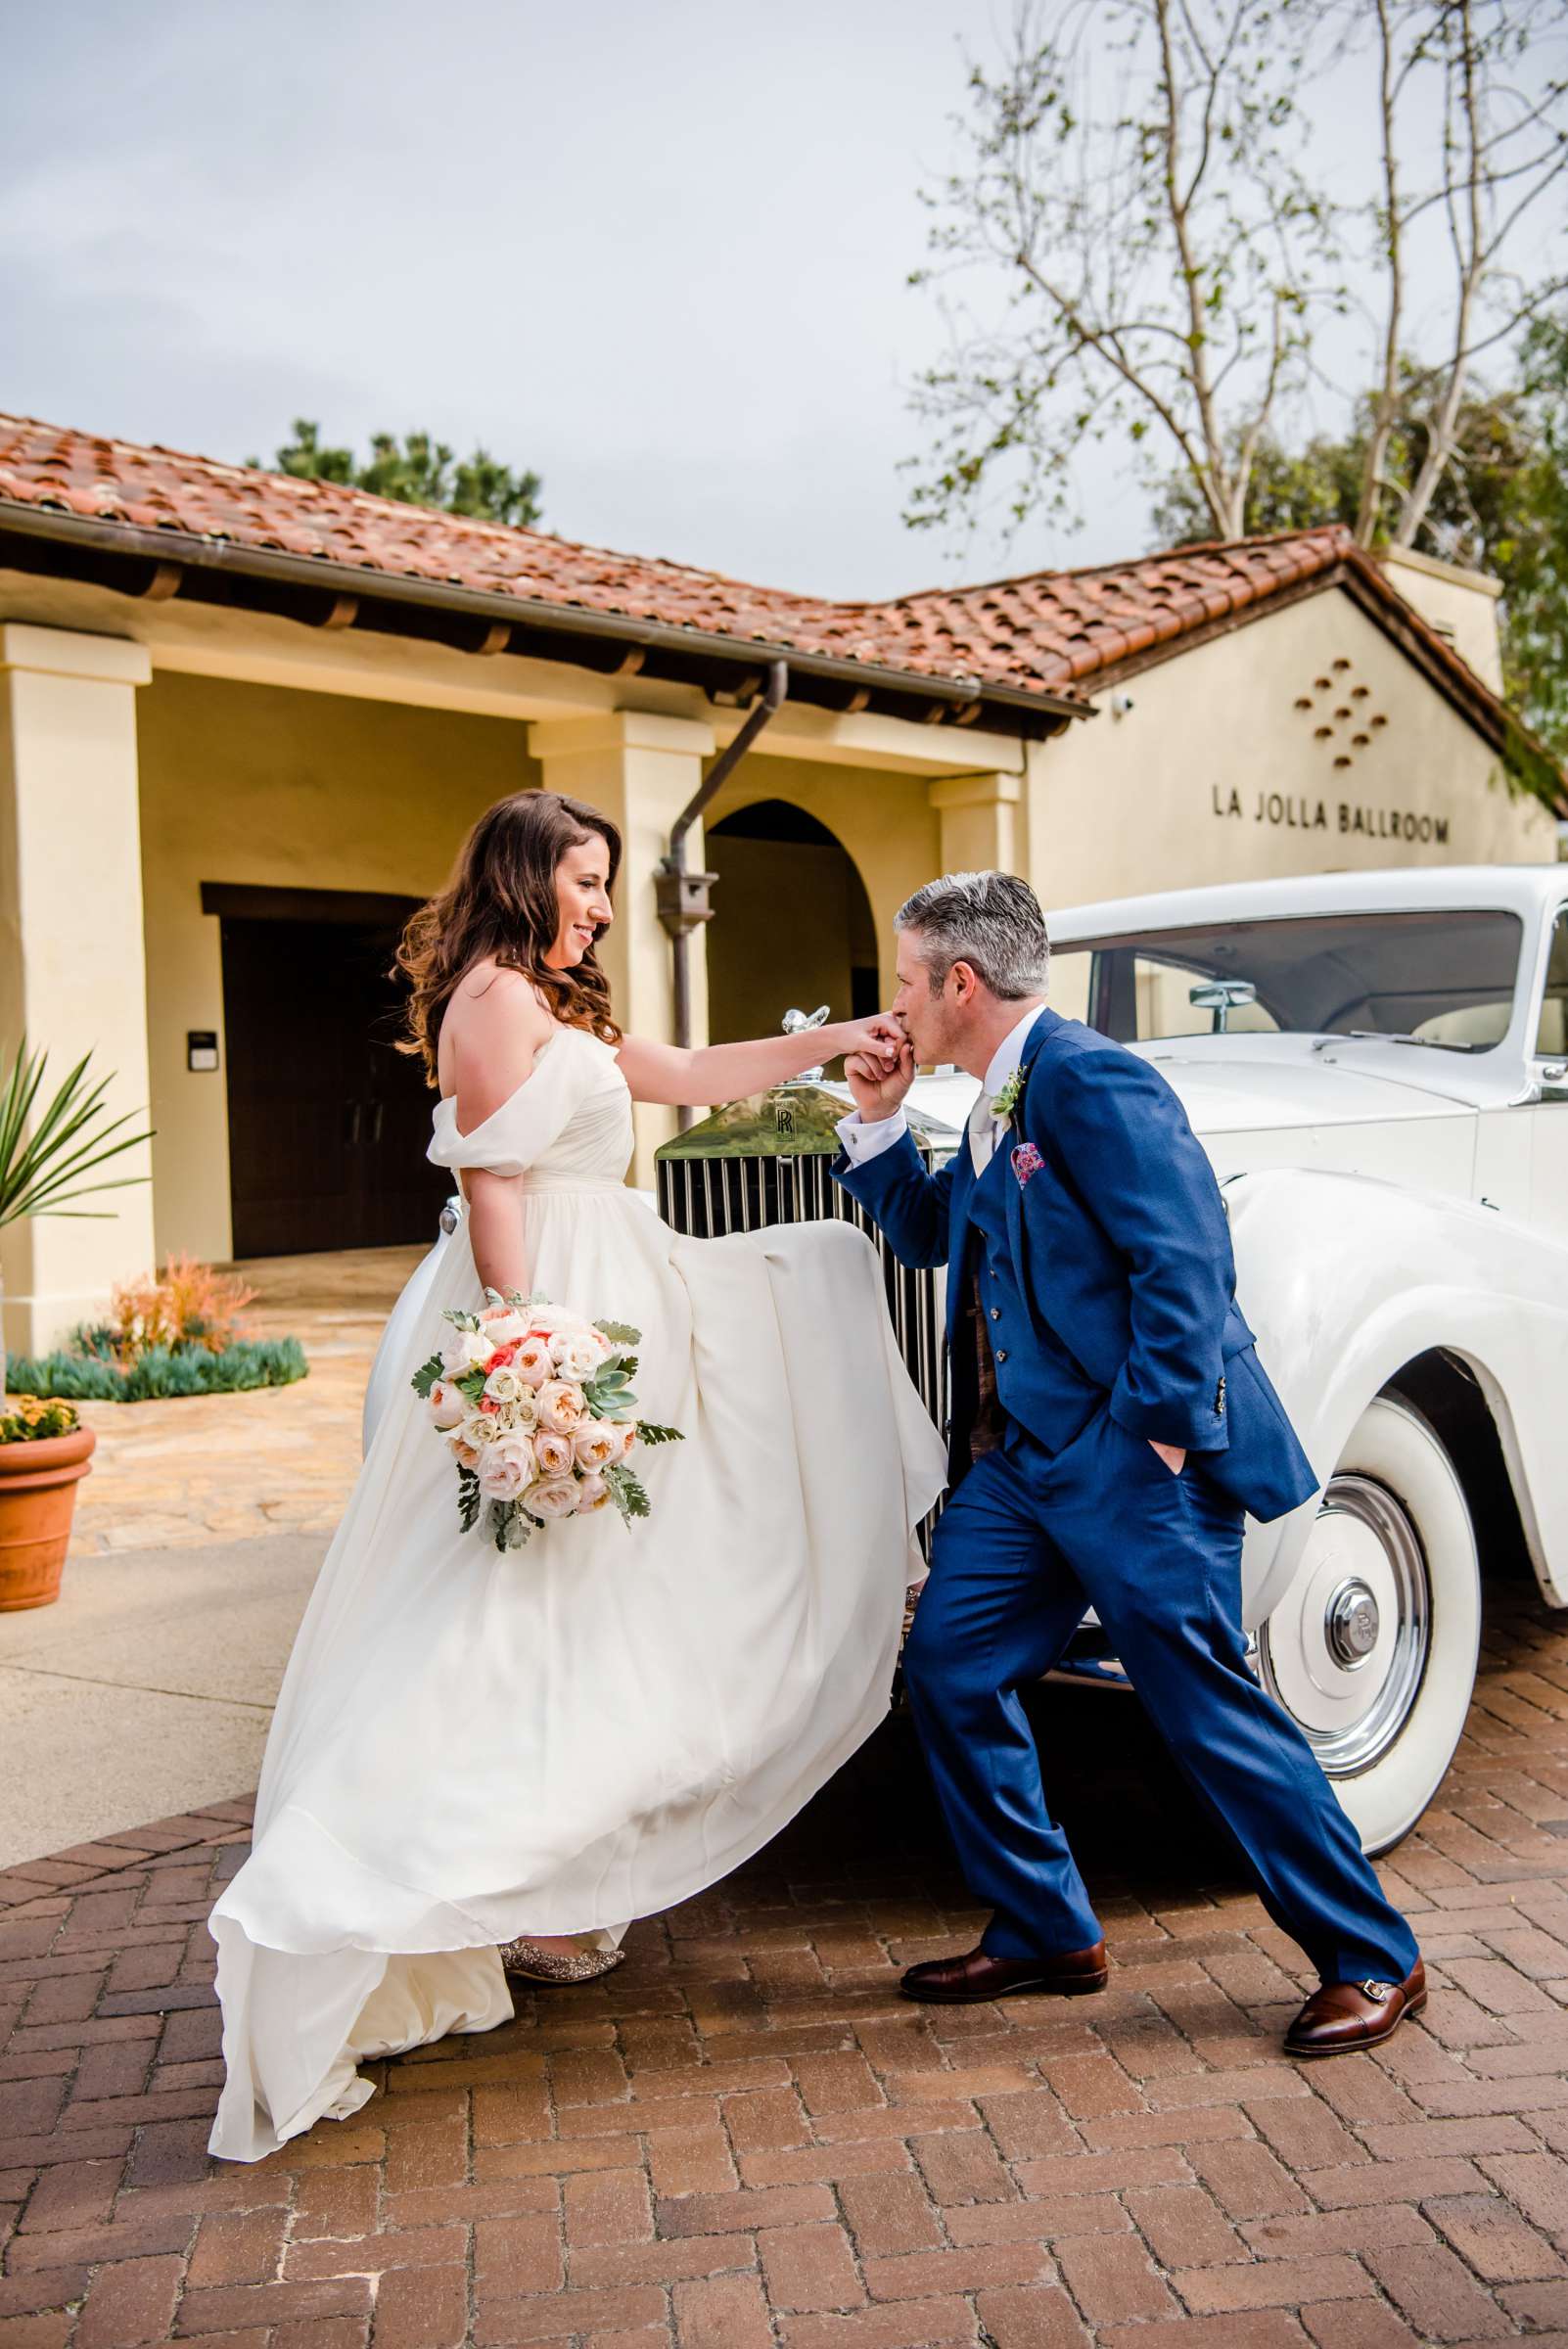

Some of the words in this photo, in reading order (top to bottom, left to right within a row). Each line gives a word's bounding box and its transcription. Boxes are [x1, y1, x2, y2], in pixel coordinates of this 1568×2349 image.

[1213, 784, 1241, 817] LA
[1255, 792, 1326, 830] JOLLA
[1338, 804, 1449, 844] BALLROOM
